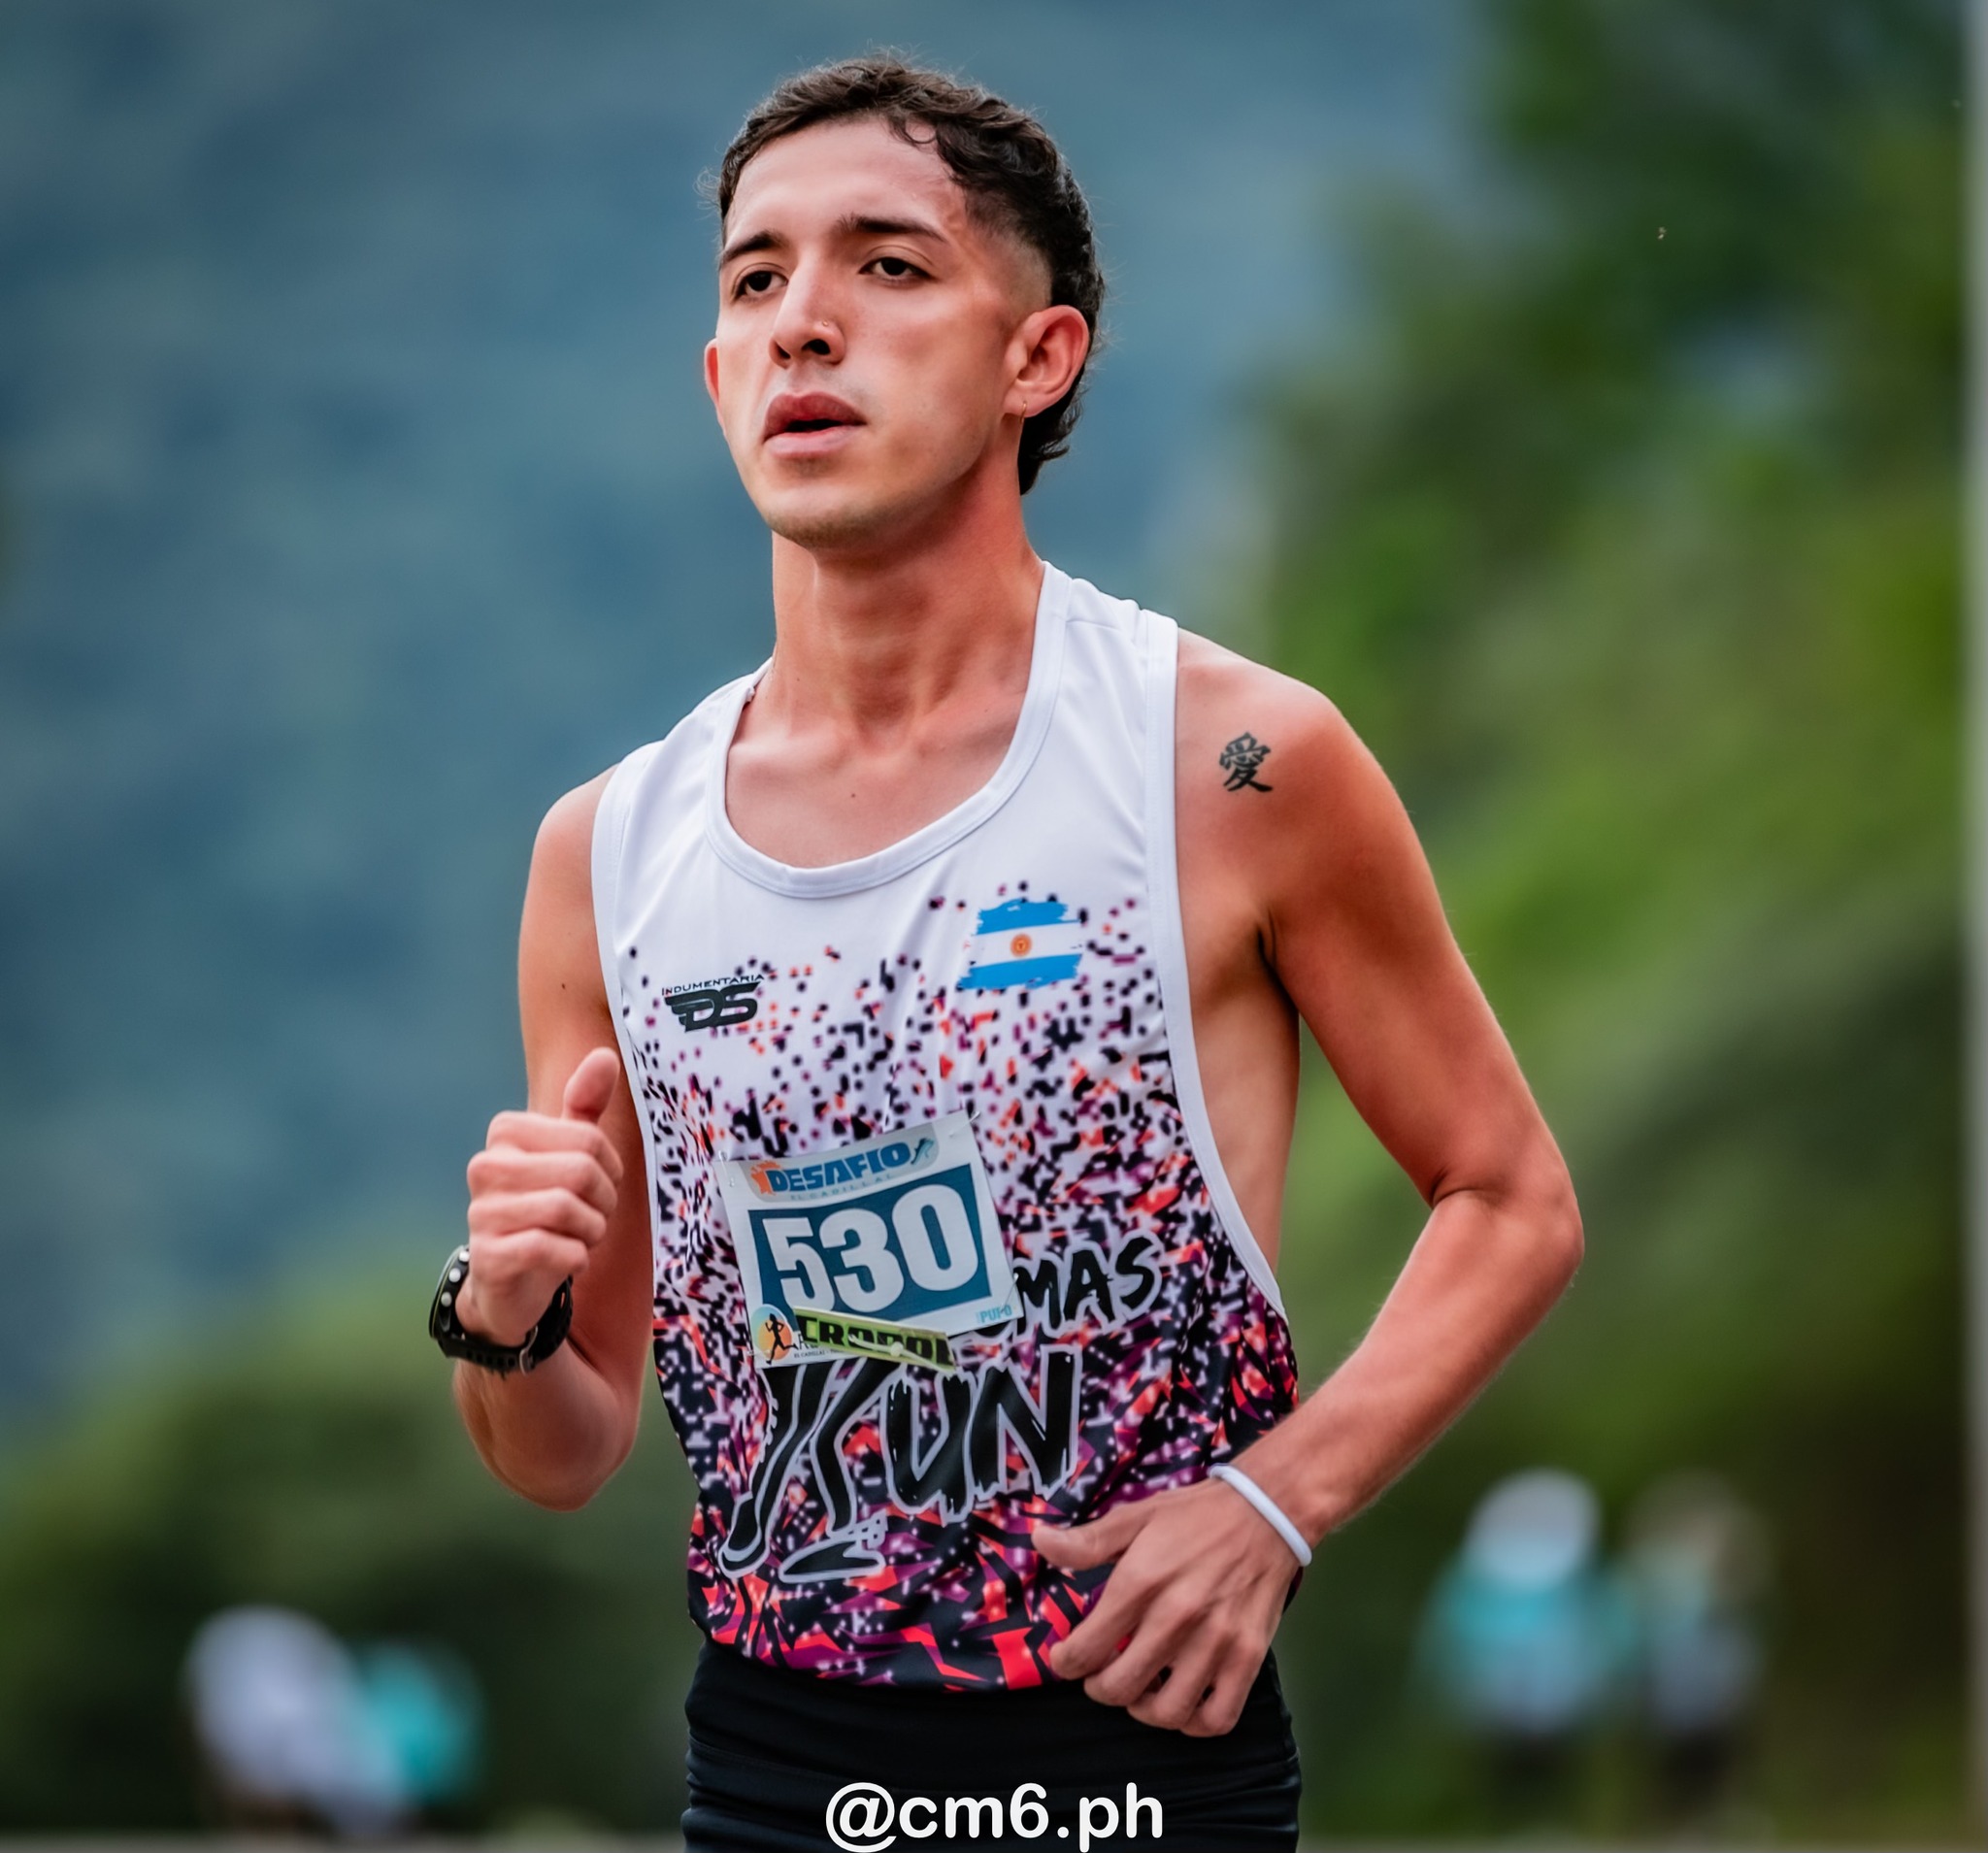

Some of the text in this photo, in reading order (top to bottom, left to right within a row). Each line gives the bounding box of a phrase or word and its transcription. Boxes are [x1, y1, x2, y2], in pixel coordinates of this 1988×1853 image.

[1219, 732, 1274, 792] 愛
[662, 974, 765, 997] INDUMENTARIA
[664, 982, 761, 1034] DS
[765, 1142, 911, 1193] DESAFIO
[762, 1183, 979, 1313] 530
